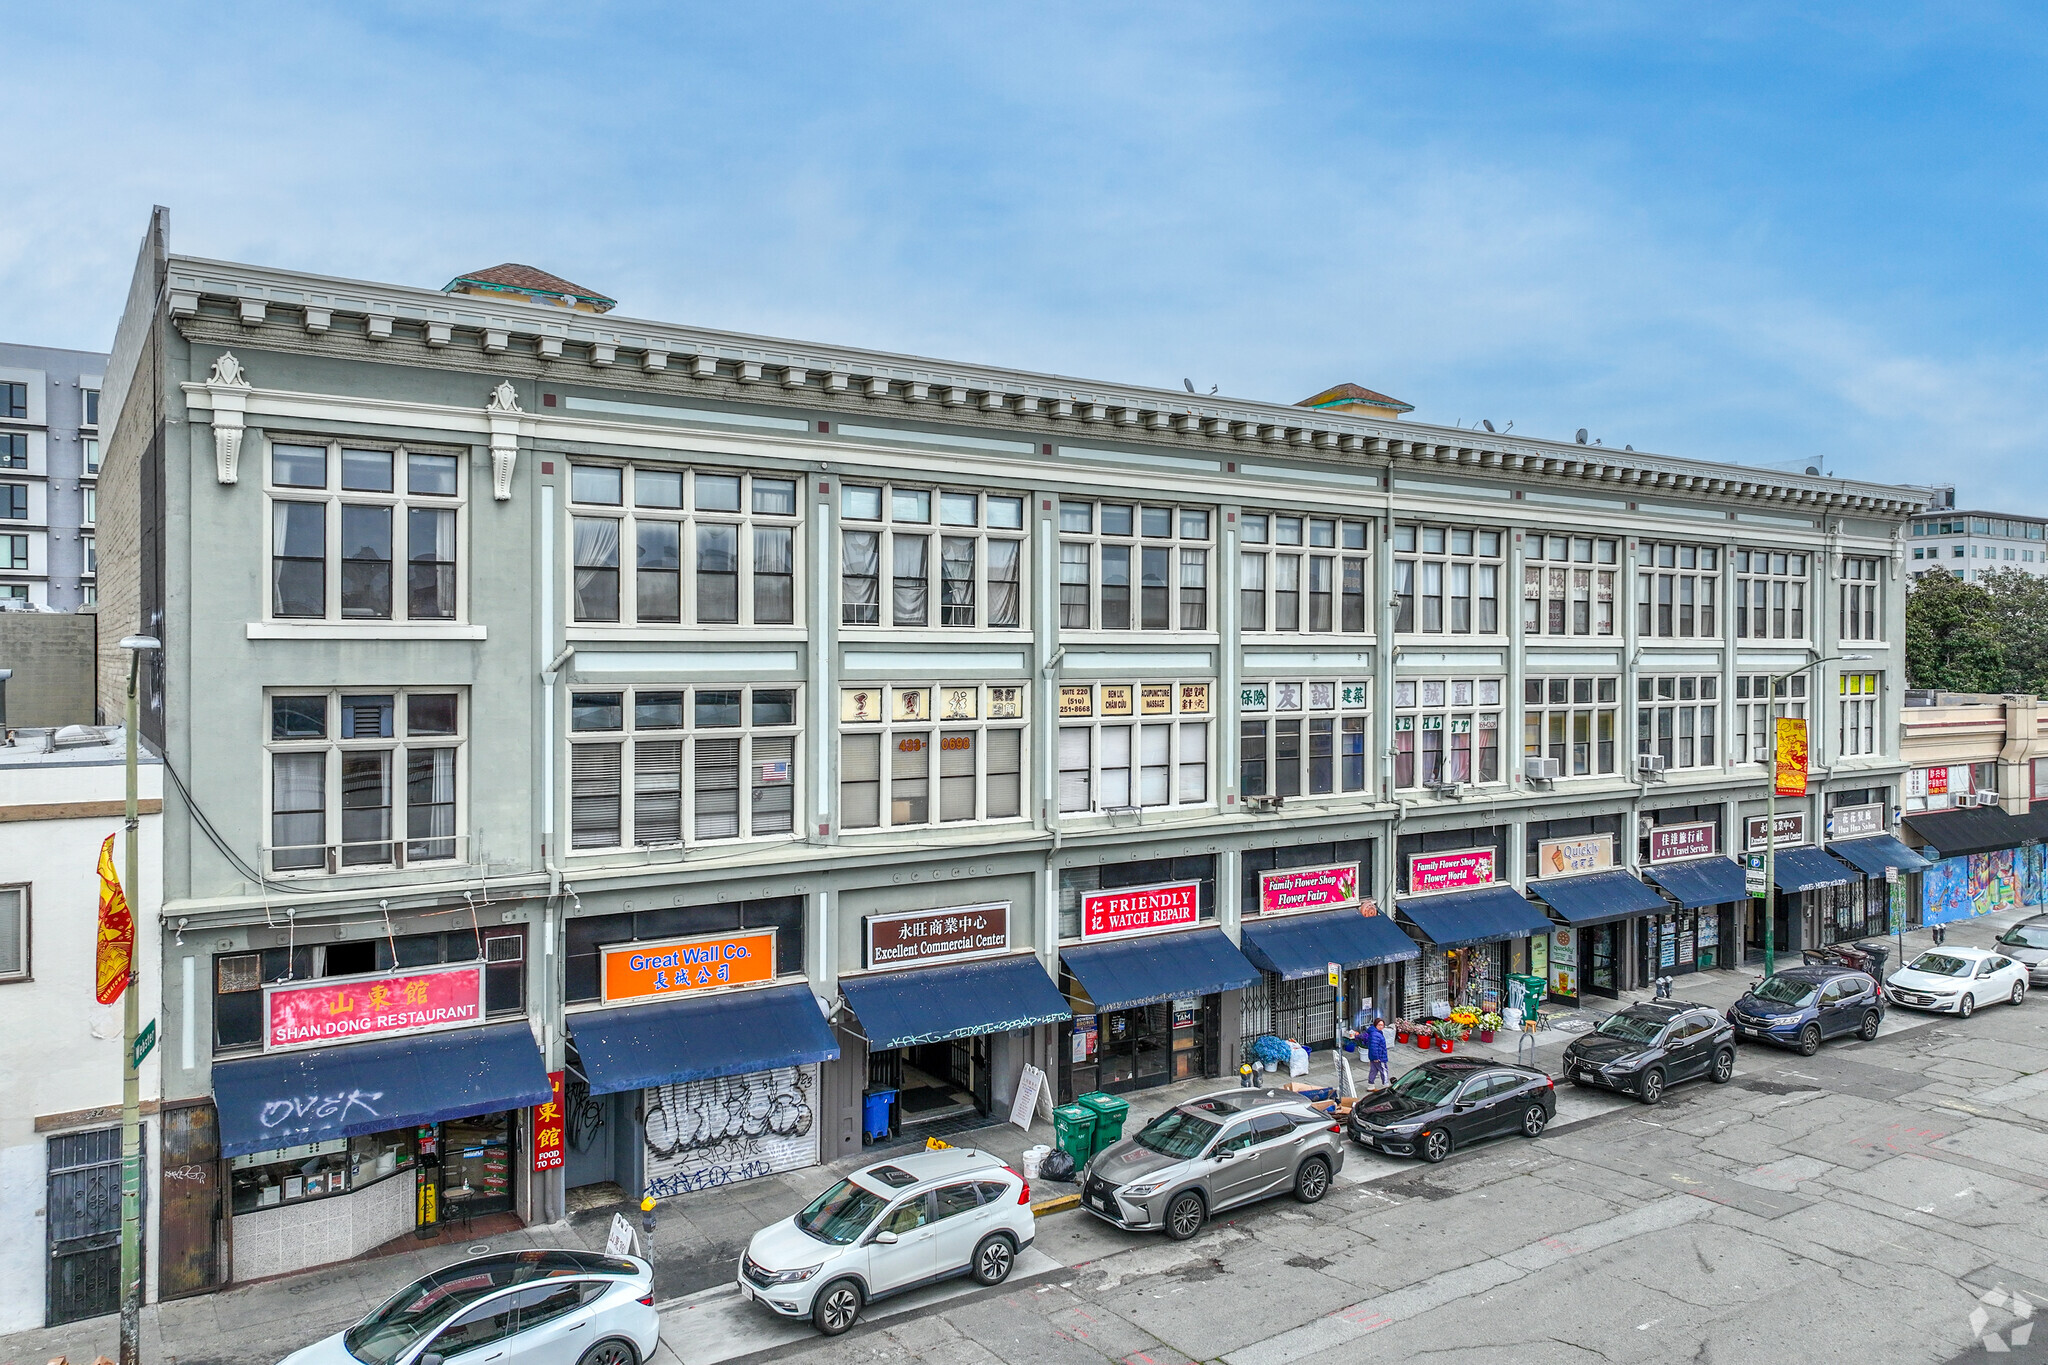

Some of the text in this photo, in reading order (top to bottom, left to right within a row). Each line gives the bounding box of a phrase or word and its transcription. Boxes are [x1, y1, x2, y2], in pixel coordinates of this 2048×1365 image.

[1067, 697, 1085, 705] (510)
[1141, 688, 1170, 698] ACUPUNCTURE
[1241, 689, 1266, 706] 保險
[1059, 705, 1091, 713] 251-8668
[1850, 824, 1861, 833] Hua
[1563, 842, 1600, 859] Quickly
[1673, 845, 1690, 856] Travel
[1689, 844, 1709, 854] Service
[1417, 857, 1476, 872] Family Flower Shop
[1269, 874, 1337, 891] Family Flower Shop
[1423, 870, 1468, 884] Flower World
[1109, 892, 1191, 913] FRIENDLY
[1278, 889, 1328, 906] Flower Fairy
[1092, 900, 1104, 931] 仁記
[1109, 906, 1191, 928] WATCH REPAIR
[898, 915, 988, 940] 永旺商業中心
[874, 933, 1005, 961] Excellent Commercial Center
[629, 943, 751, 971] Great Wall Co.
[654, 963, 730, 990] 長城公司
[101, 973, 125, 1001] CHINATOWN
[329, 980, 430, 1015] 山東館
[276, 1004, 476, 1041] SHAN DONG RESTAURANT
[1177, 1012, 1191, 1022] TAM
[135, 1029, 155, 1060] Webster
[91, 1109, 105, 1117] 34
[536, 1157, 562, 1169] TO GO
[538, 1150, 560, 1159] FOOD
